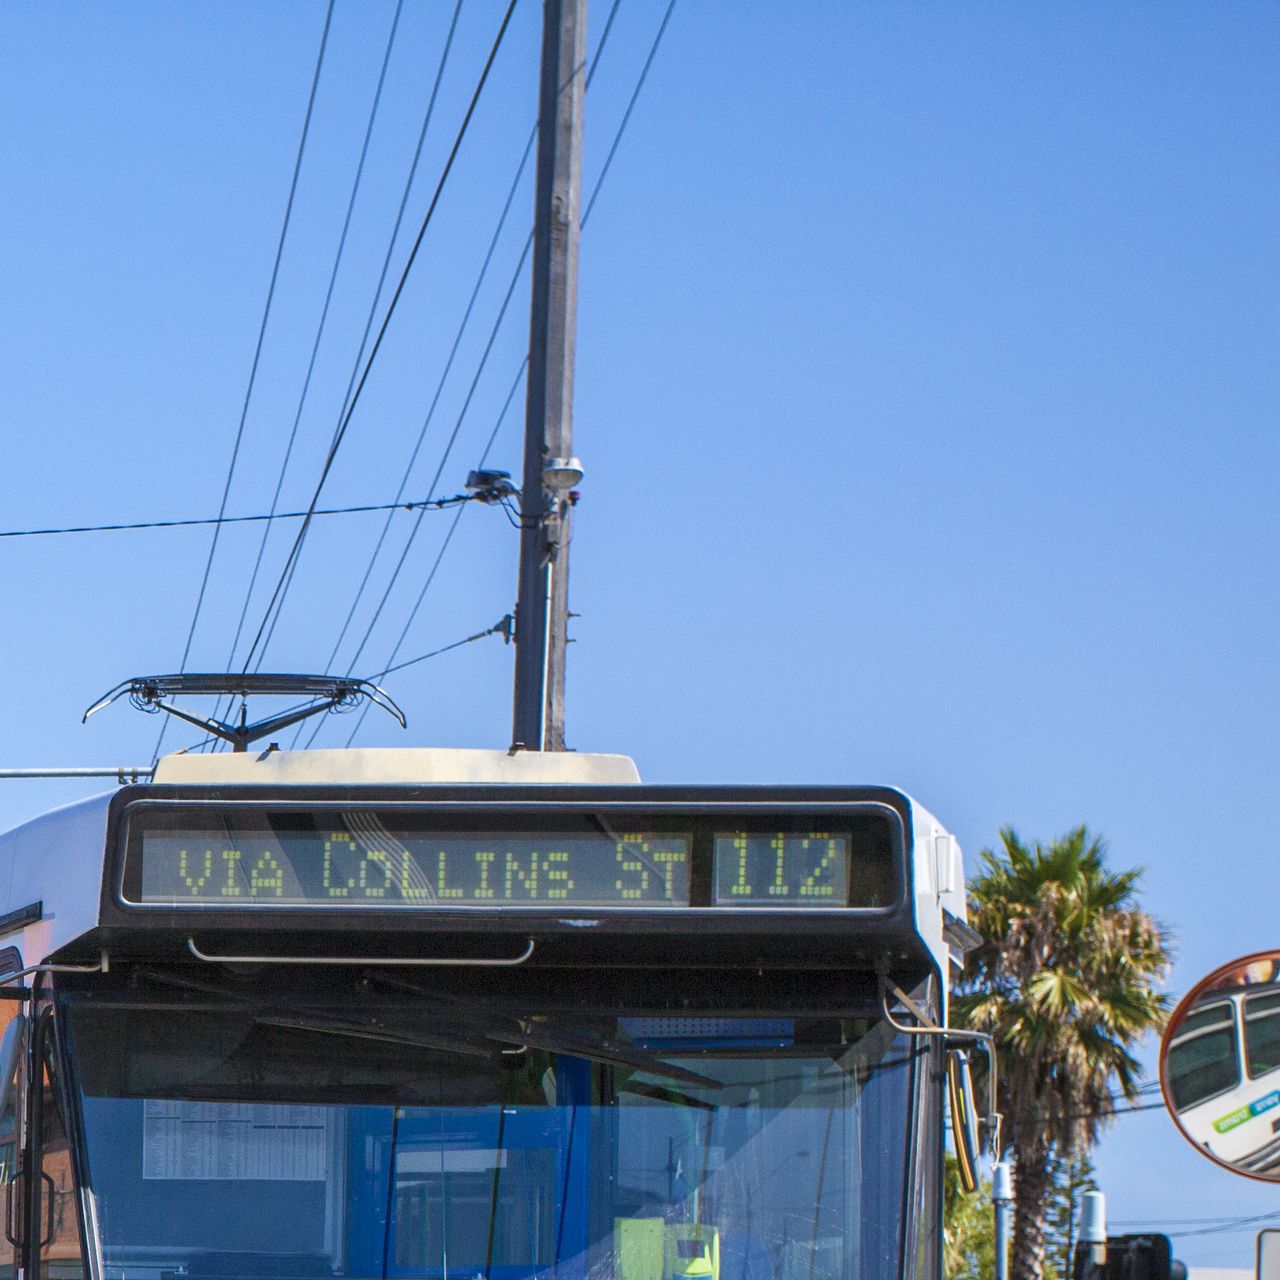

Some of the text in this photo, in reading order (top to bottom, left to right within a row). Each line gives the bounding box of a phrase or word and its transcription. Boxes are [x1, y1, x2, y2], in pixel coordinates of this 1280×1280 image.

[181, 832, 836, 898] VIA COLLINS ST 112
